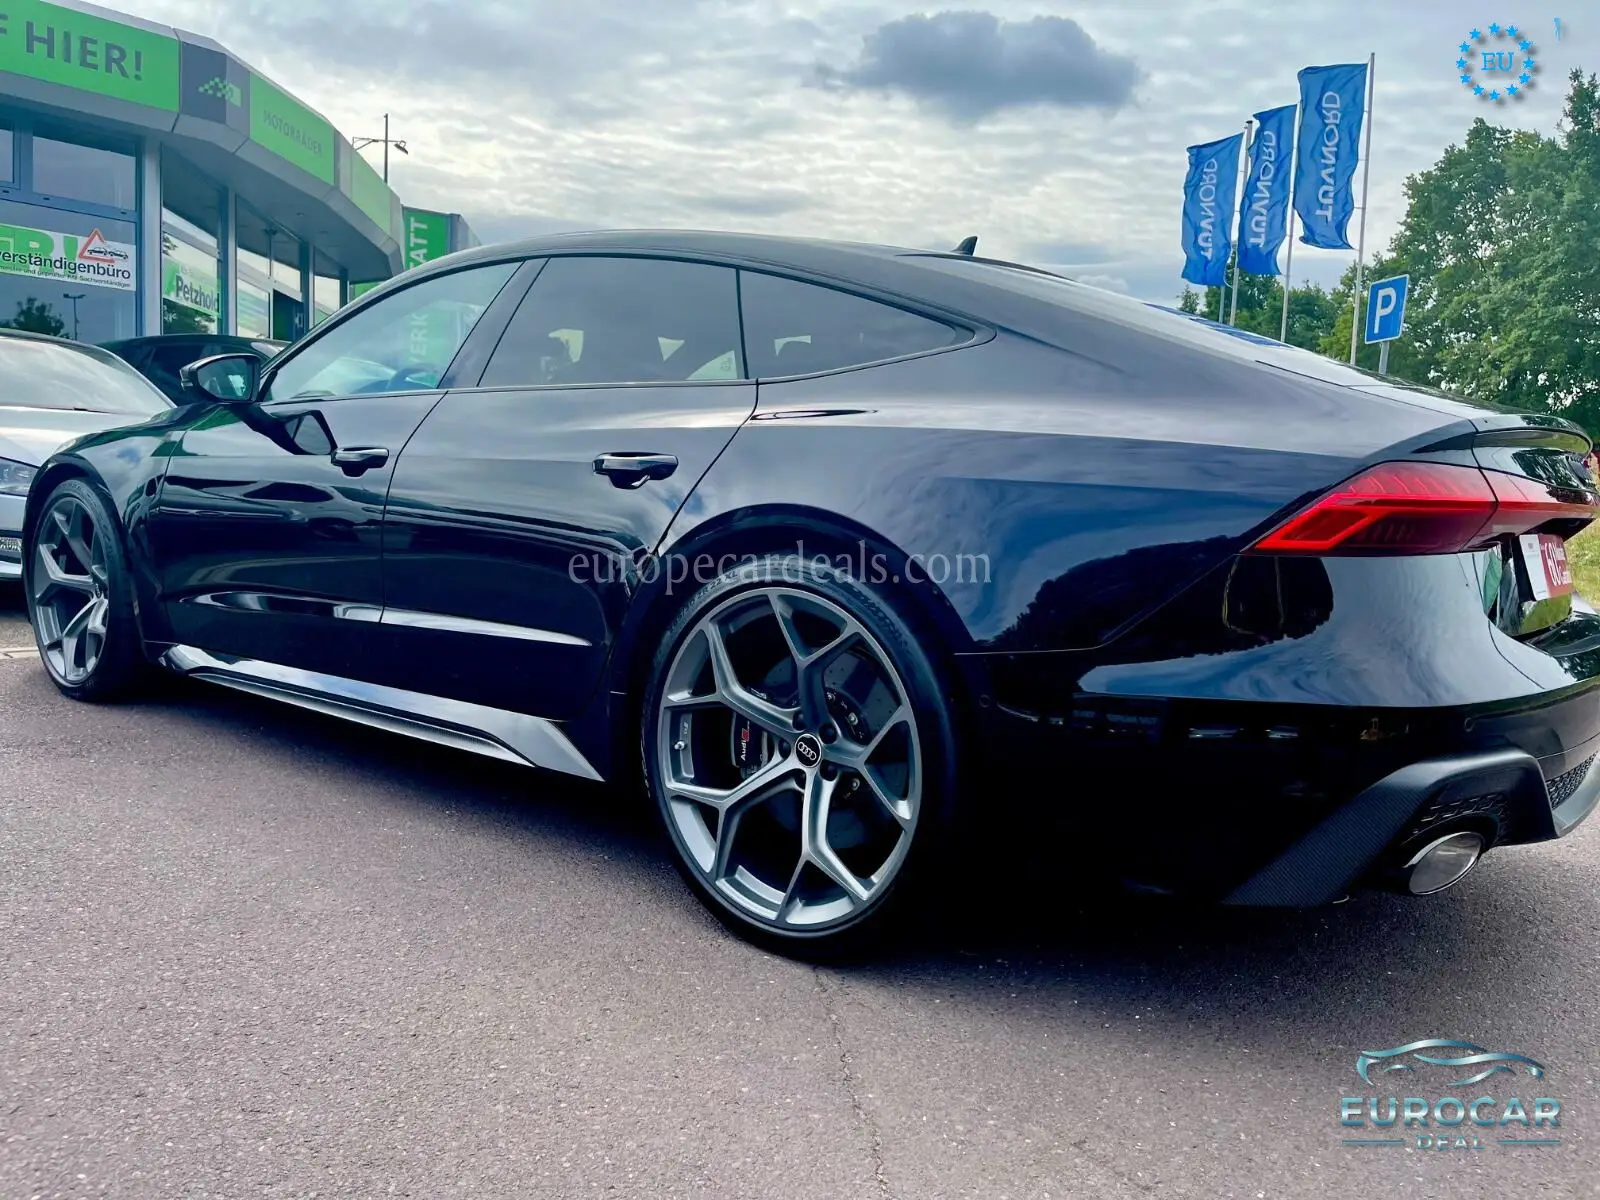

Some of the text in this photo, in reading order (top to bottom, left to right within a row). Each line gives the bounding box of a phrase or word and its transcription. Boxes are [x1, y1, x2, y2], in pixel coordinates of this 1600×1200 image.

[26, 21, 142, 80] HIER!
[0, 250, 131, 280] erständigenbüro
[1374, 288, 1396, 334] P
